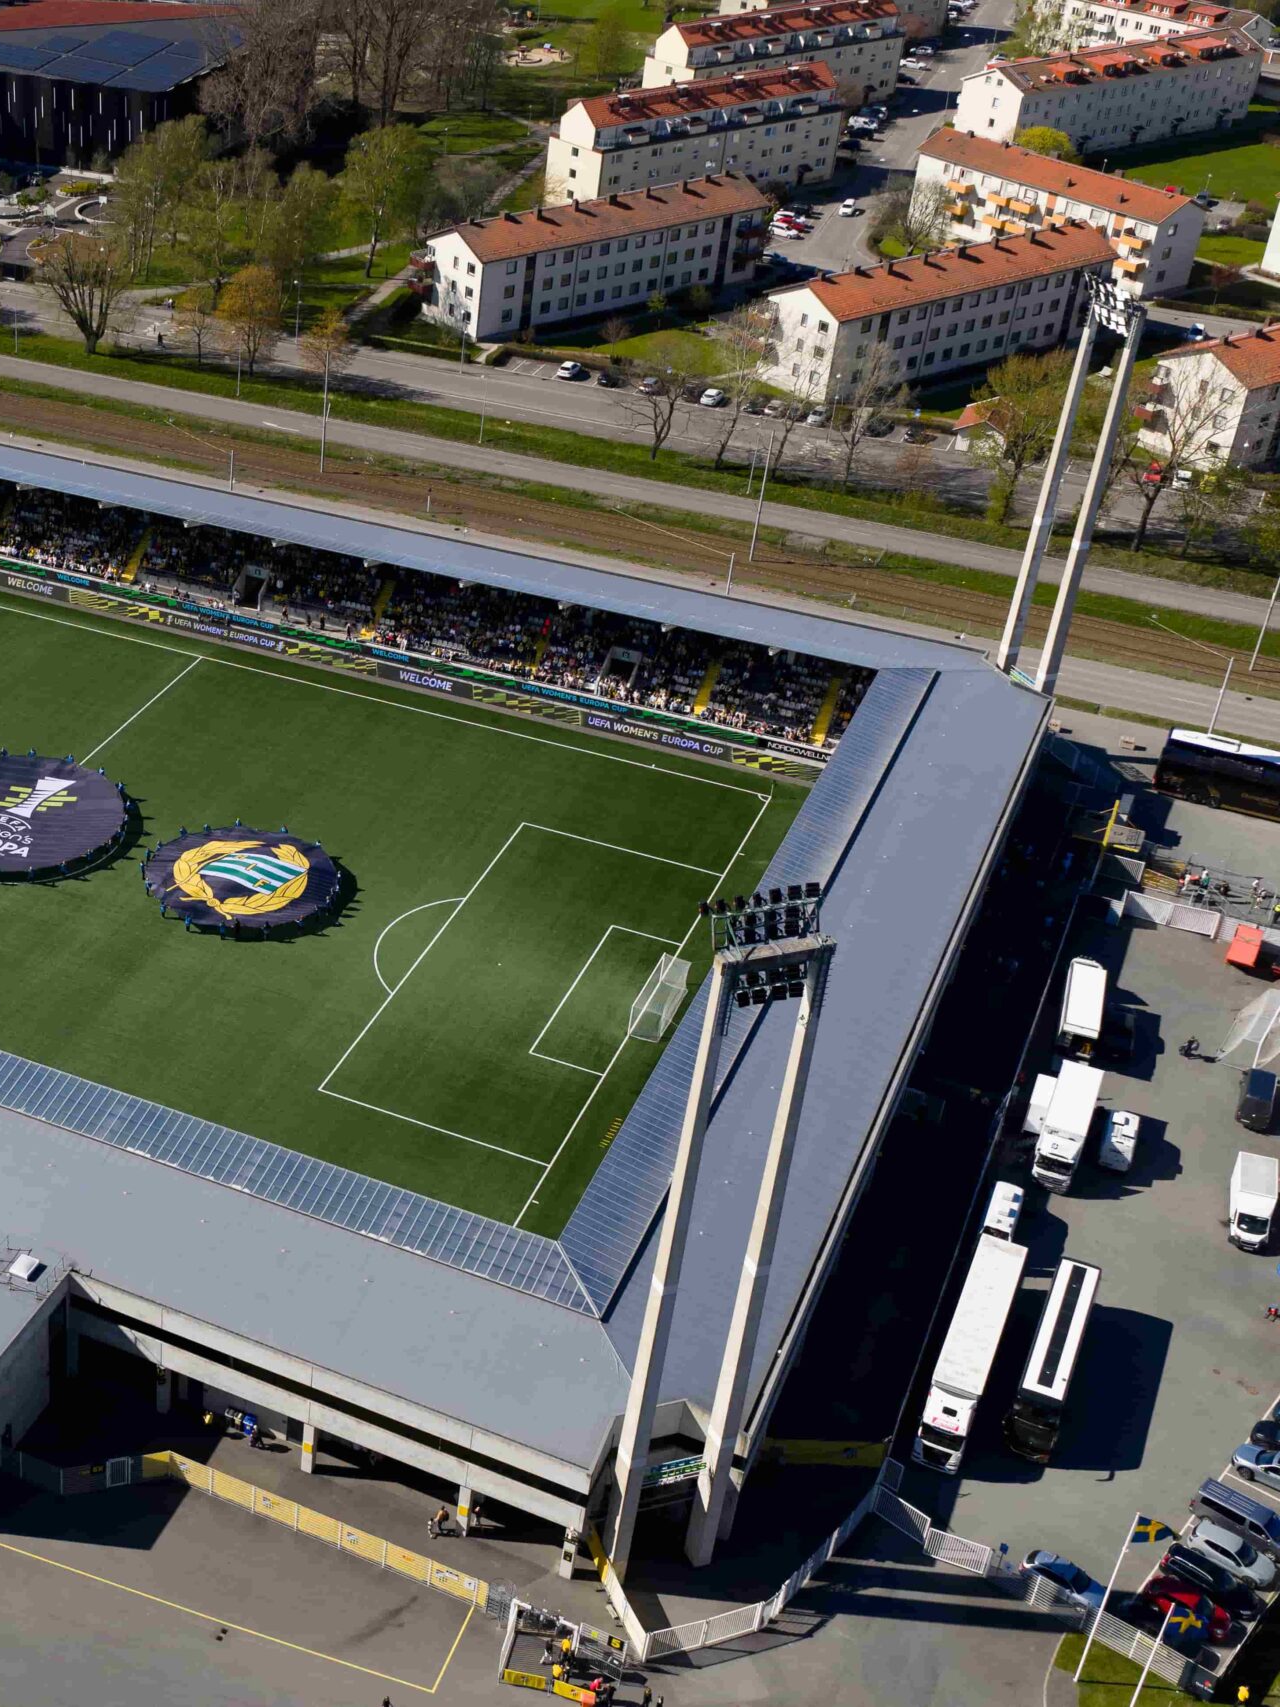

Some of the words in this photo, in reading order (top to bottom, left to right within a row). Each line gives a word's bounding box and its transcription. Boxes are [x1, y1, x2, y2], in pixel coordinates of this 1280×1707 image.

[7, 576, 54, 596] WELCOME
[57, 573, 91, 587] WELCOME
[182, 603, 199, 613] UEFA
[199, 606, 231, 620] WOMEN'S
[232, 615, 259, 628] EUROPA
[259, 621, 275, 630] CUP
[174, 617, 192, 629] UEFA
[193, 622, 228, 637] WOMEN'S
[229, 631, 258, 644] EUROPA
[259, 638, 276, 648] CUP
[372, 648, 410, 663] WELCOME
[399, 670, 454, 691] WELCOME
[521, 683, 540, 694] UEFA
[541, 687, 578, 702] WOMEN'S
[579, 696, 610, 710] EUROPA
[611, 703, 629, 714] CUP
[587, 716, 611, 730] UEFA
[613, 722, 659, 741] WOMEN'S
[661, 734, 700, 751] EUROPA
[702, 743, 724, 756] CUP
[610, 1638, 621, 1649] 5
